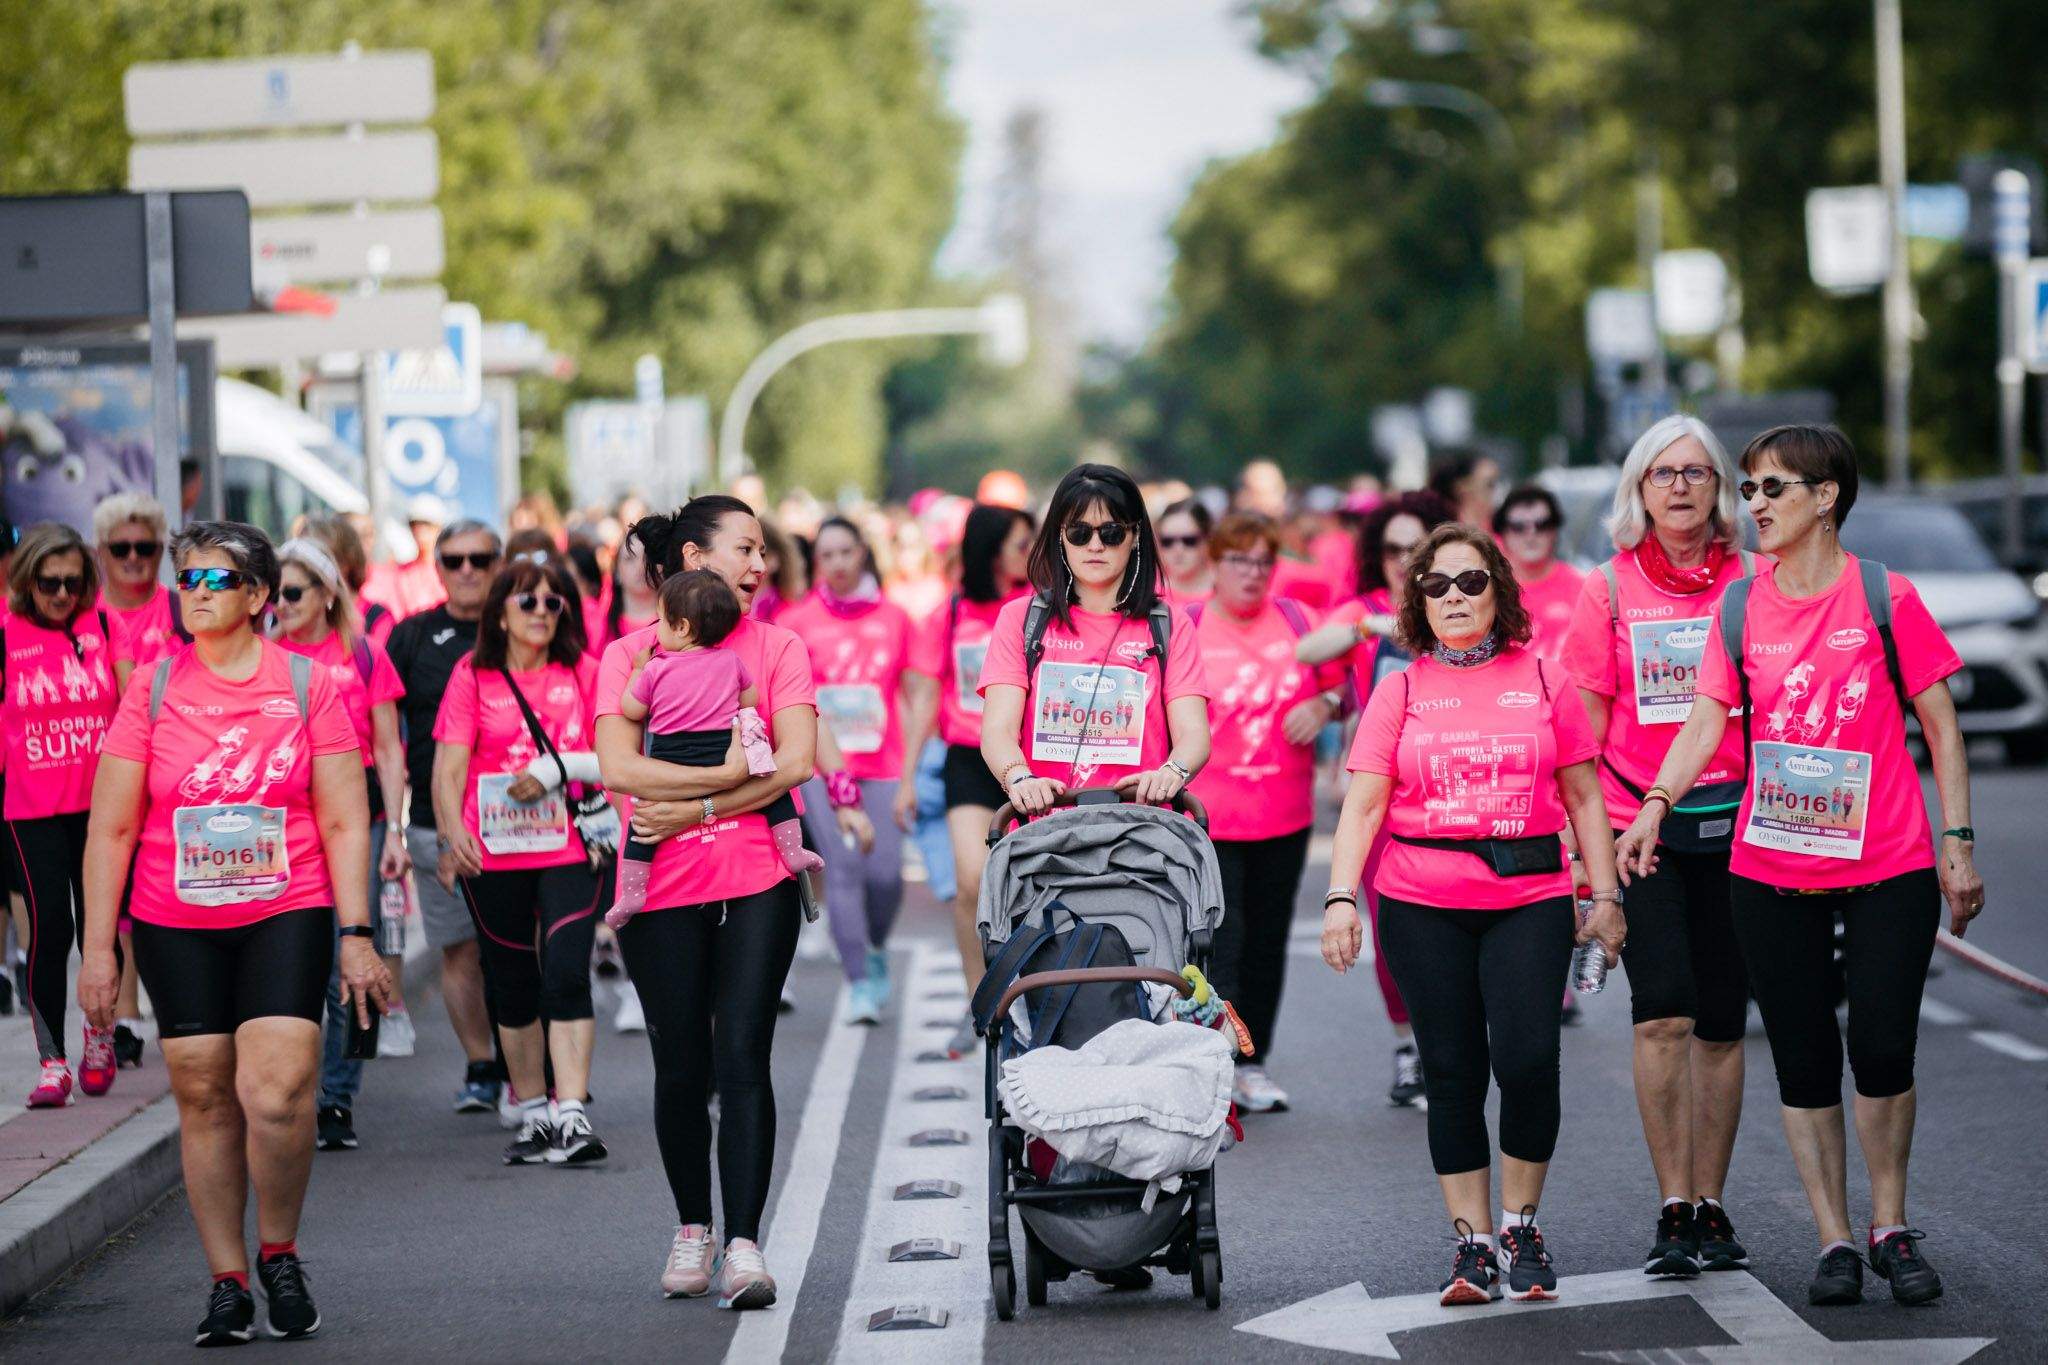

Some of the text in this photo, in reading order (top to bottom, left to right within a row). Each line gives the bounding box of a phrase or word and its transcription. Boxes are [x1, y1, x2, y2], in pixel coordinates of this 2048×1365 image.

[1627, 605, 1673, 618] OYSHO
[1673, 665, 1698, 682] 01
[1072, 708, 1113, 725] 016
[1477, 797, 1528, 813] CHICAS
[1785, 792, 1828, 813] 016
[1790, 814, 1815, 824] 11861
[1492, 820, 1525, 836] 2019
[1759, 831, 1790, 845] OYSHO
[212, 848, 254, 866] 016
